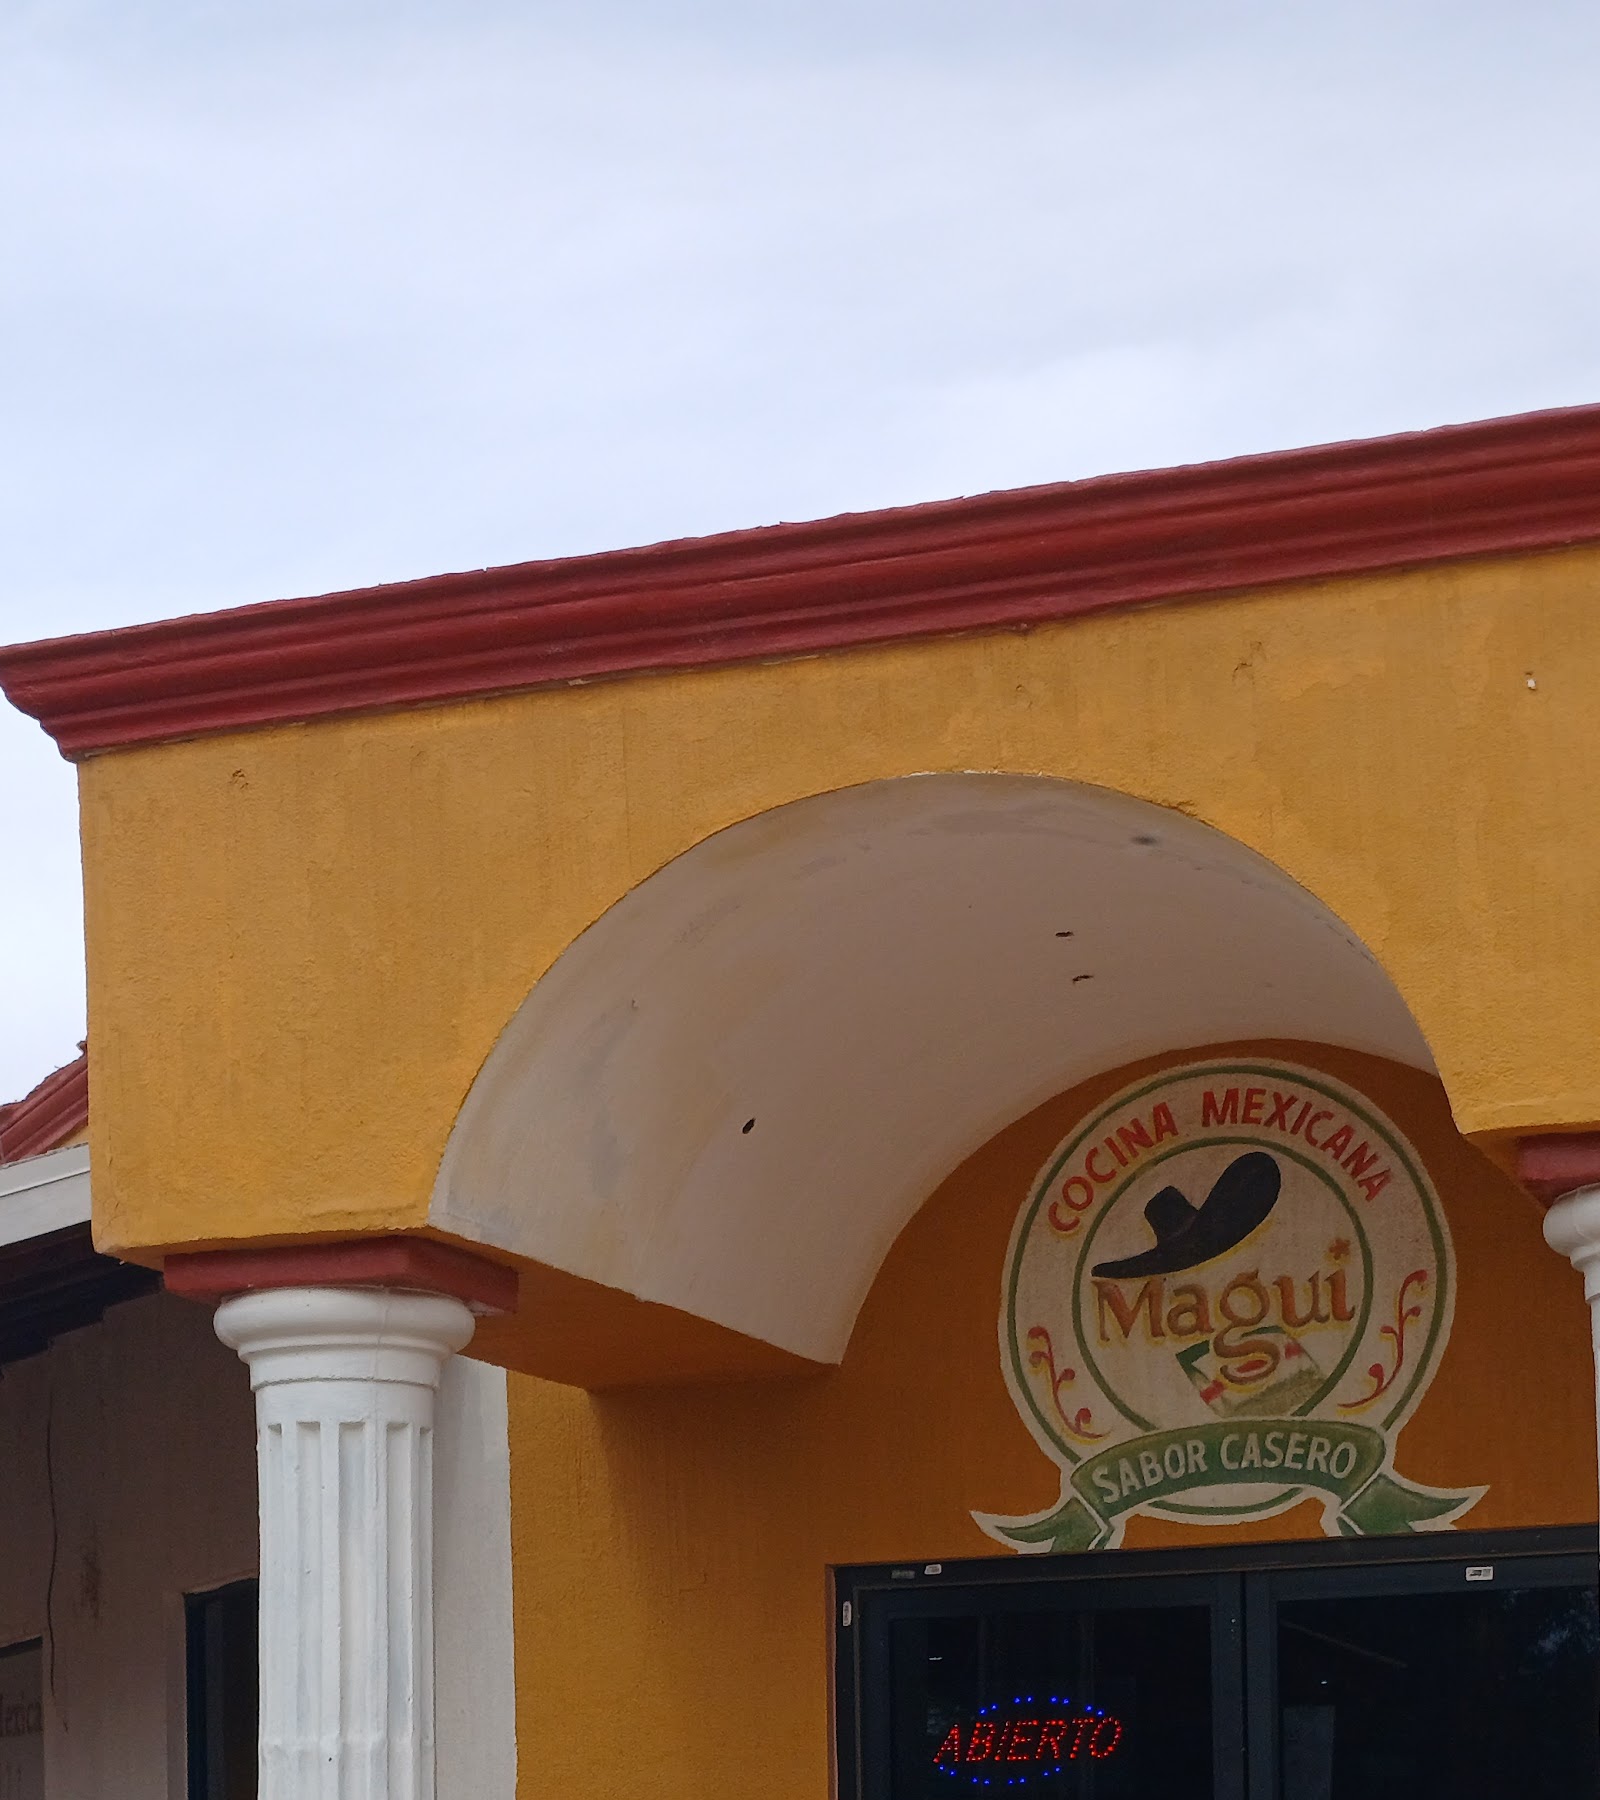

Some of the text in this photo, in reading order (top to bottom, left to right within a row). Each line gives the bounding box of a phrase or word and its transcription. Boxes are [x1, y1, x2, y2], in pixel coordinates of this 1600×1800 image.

[1048, 1088, 1392, 1232] COCINA MEXICANA
[1091, 1237, 1355, 1385] Magui
[1092, 1431, 1357, 1504] SABOR CASERO
[933, 1716, 1123, 1763] ABIERTO
